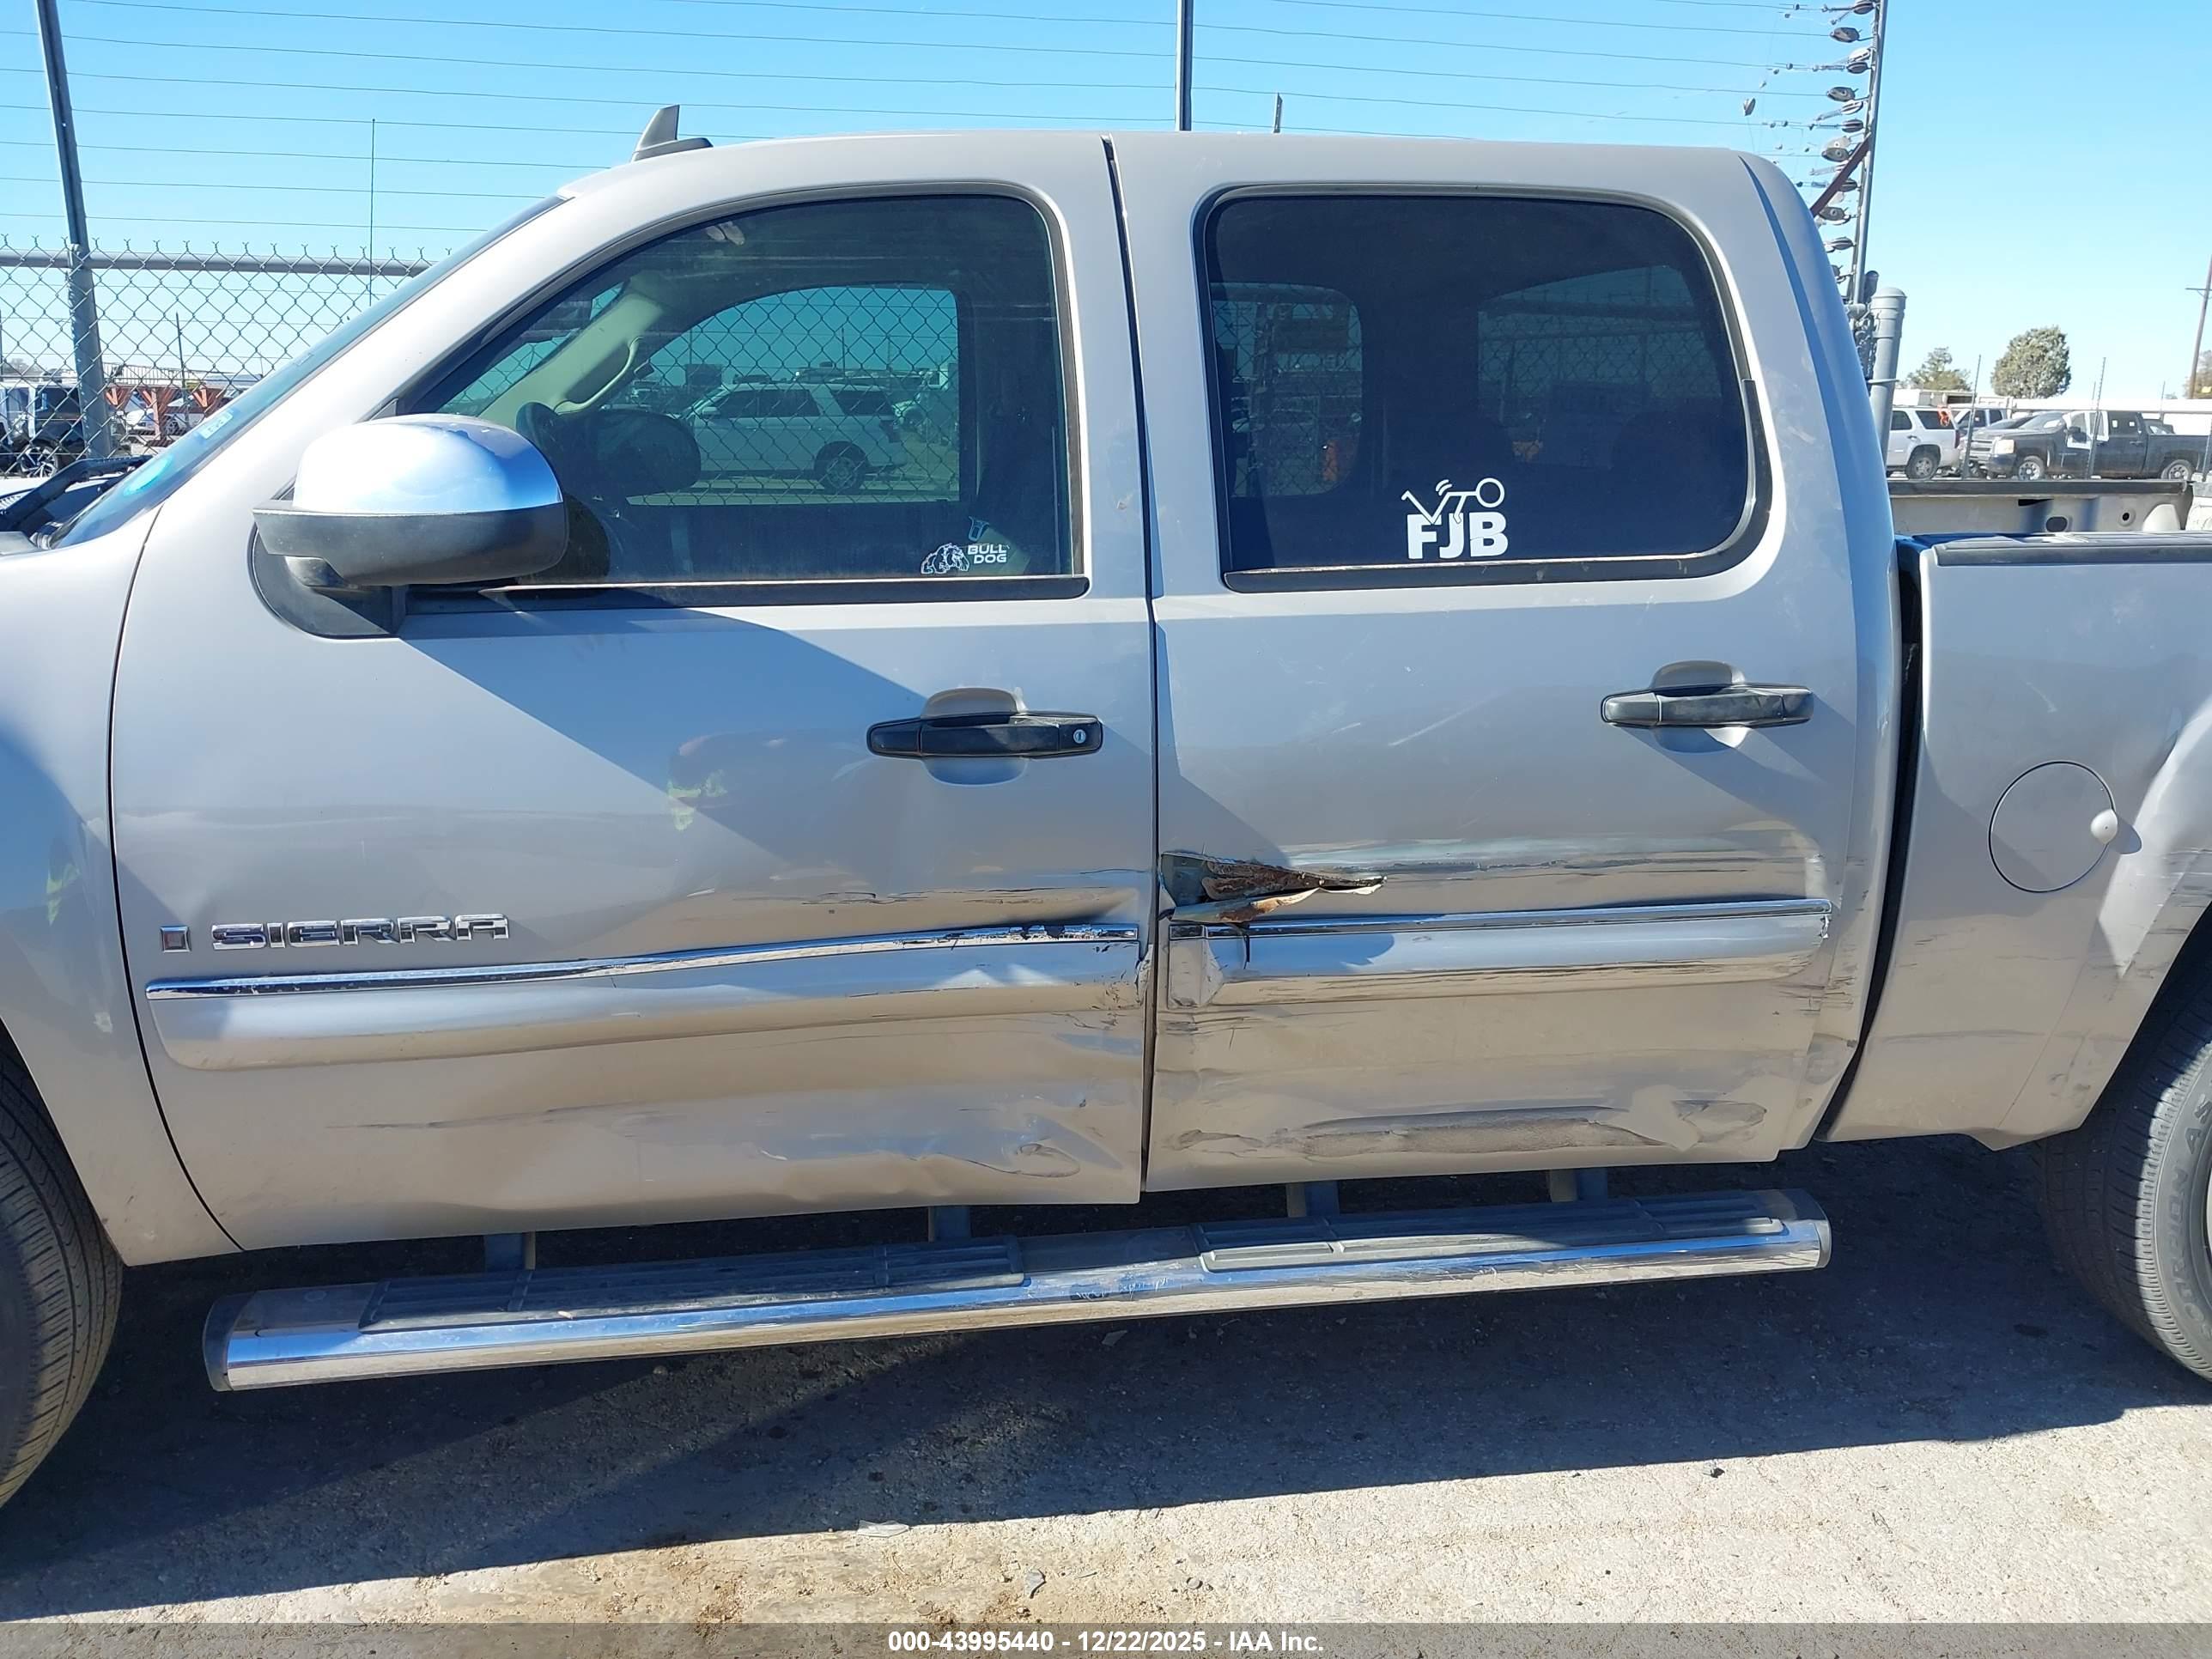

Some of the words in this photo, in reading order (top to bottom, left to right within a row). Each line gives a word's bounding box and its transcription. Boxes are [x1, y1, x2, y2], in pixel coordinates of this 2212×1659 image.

[1407, 511, 1509, 559] FJB
[967, 544, 1007, 556] BULL
[973, 554, 1007, 564] DOG
[211, 913, 509, 951] SIERRA
